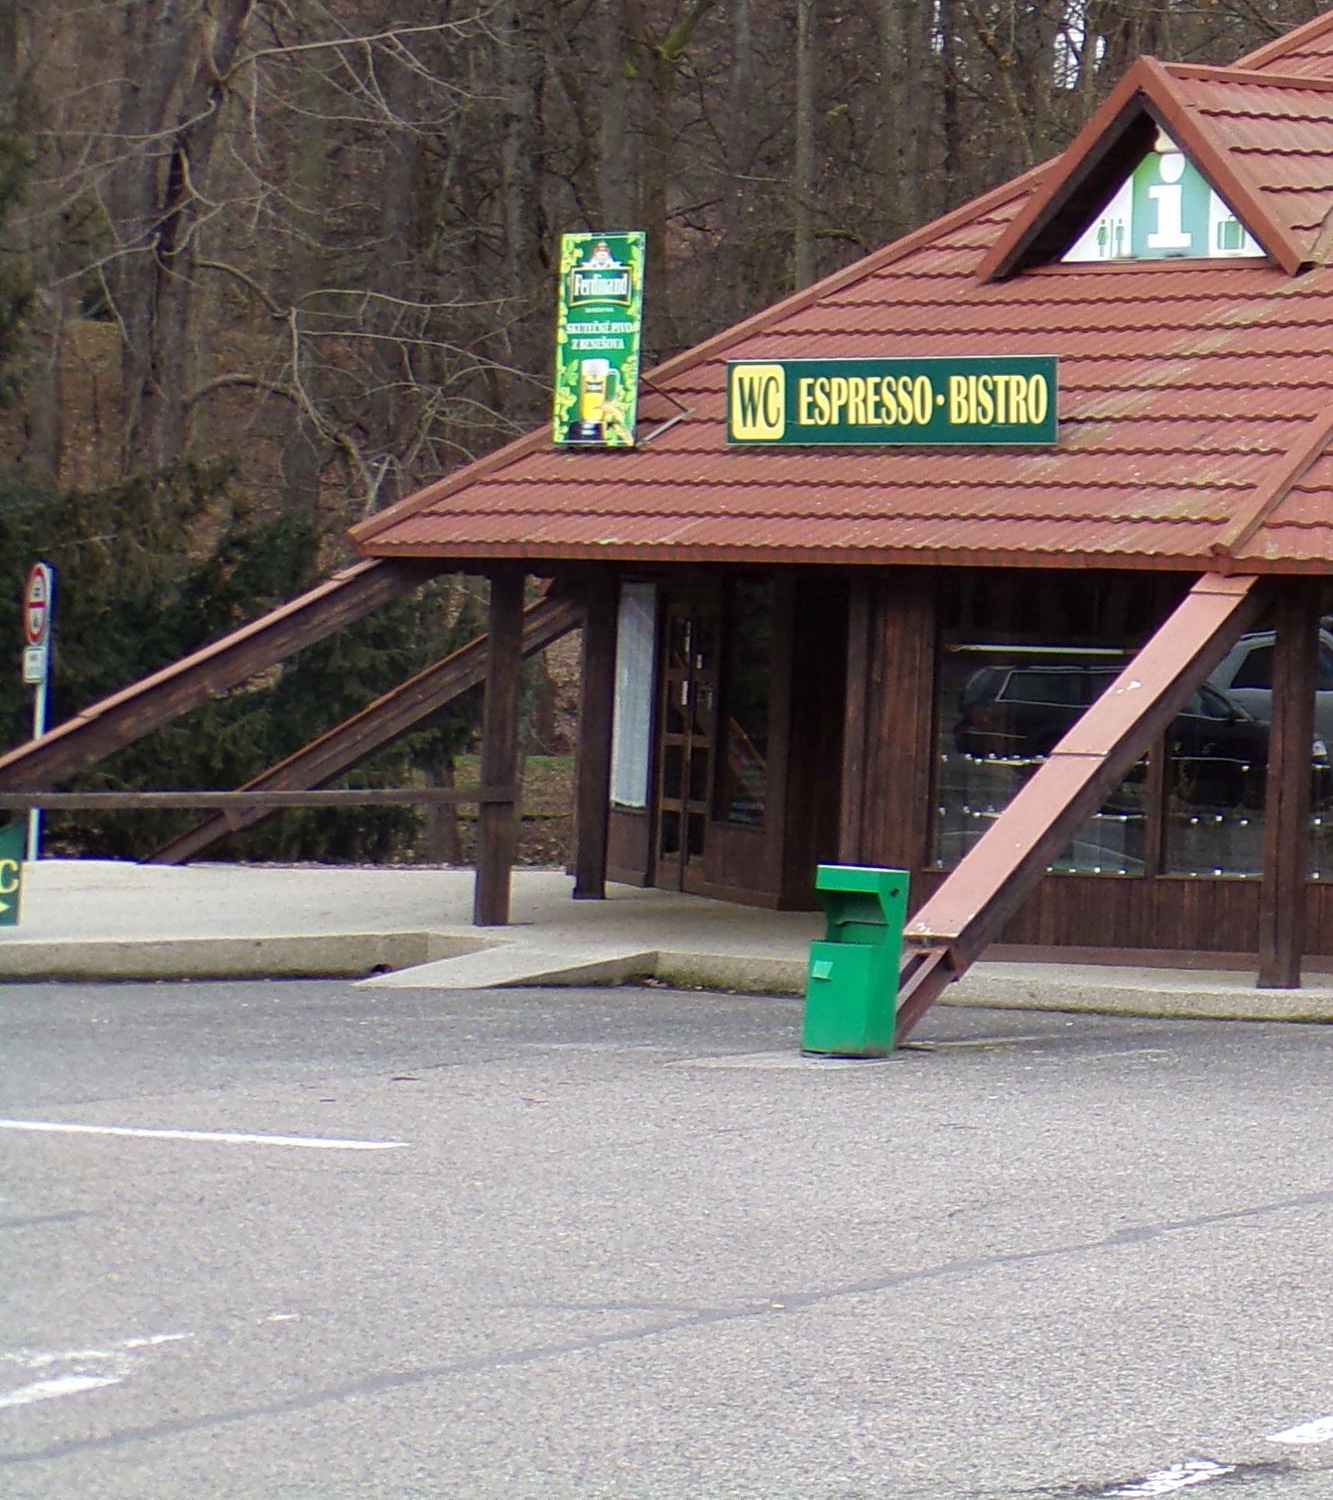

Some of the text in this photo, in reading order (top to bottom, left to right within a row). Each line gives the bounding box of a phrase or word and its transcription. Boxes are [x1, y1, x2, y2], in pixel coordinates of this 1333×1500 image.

[574, 273, 628, 296] Ferdinand
[737, 373, 1049, 428] WC ESPRESSO BISTRO
